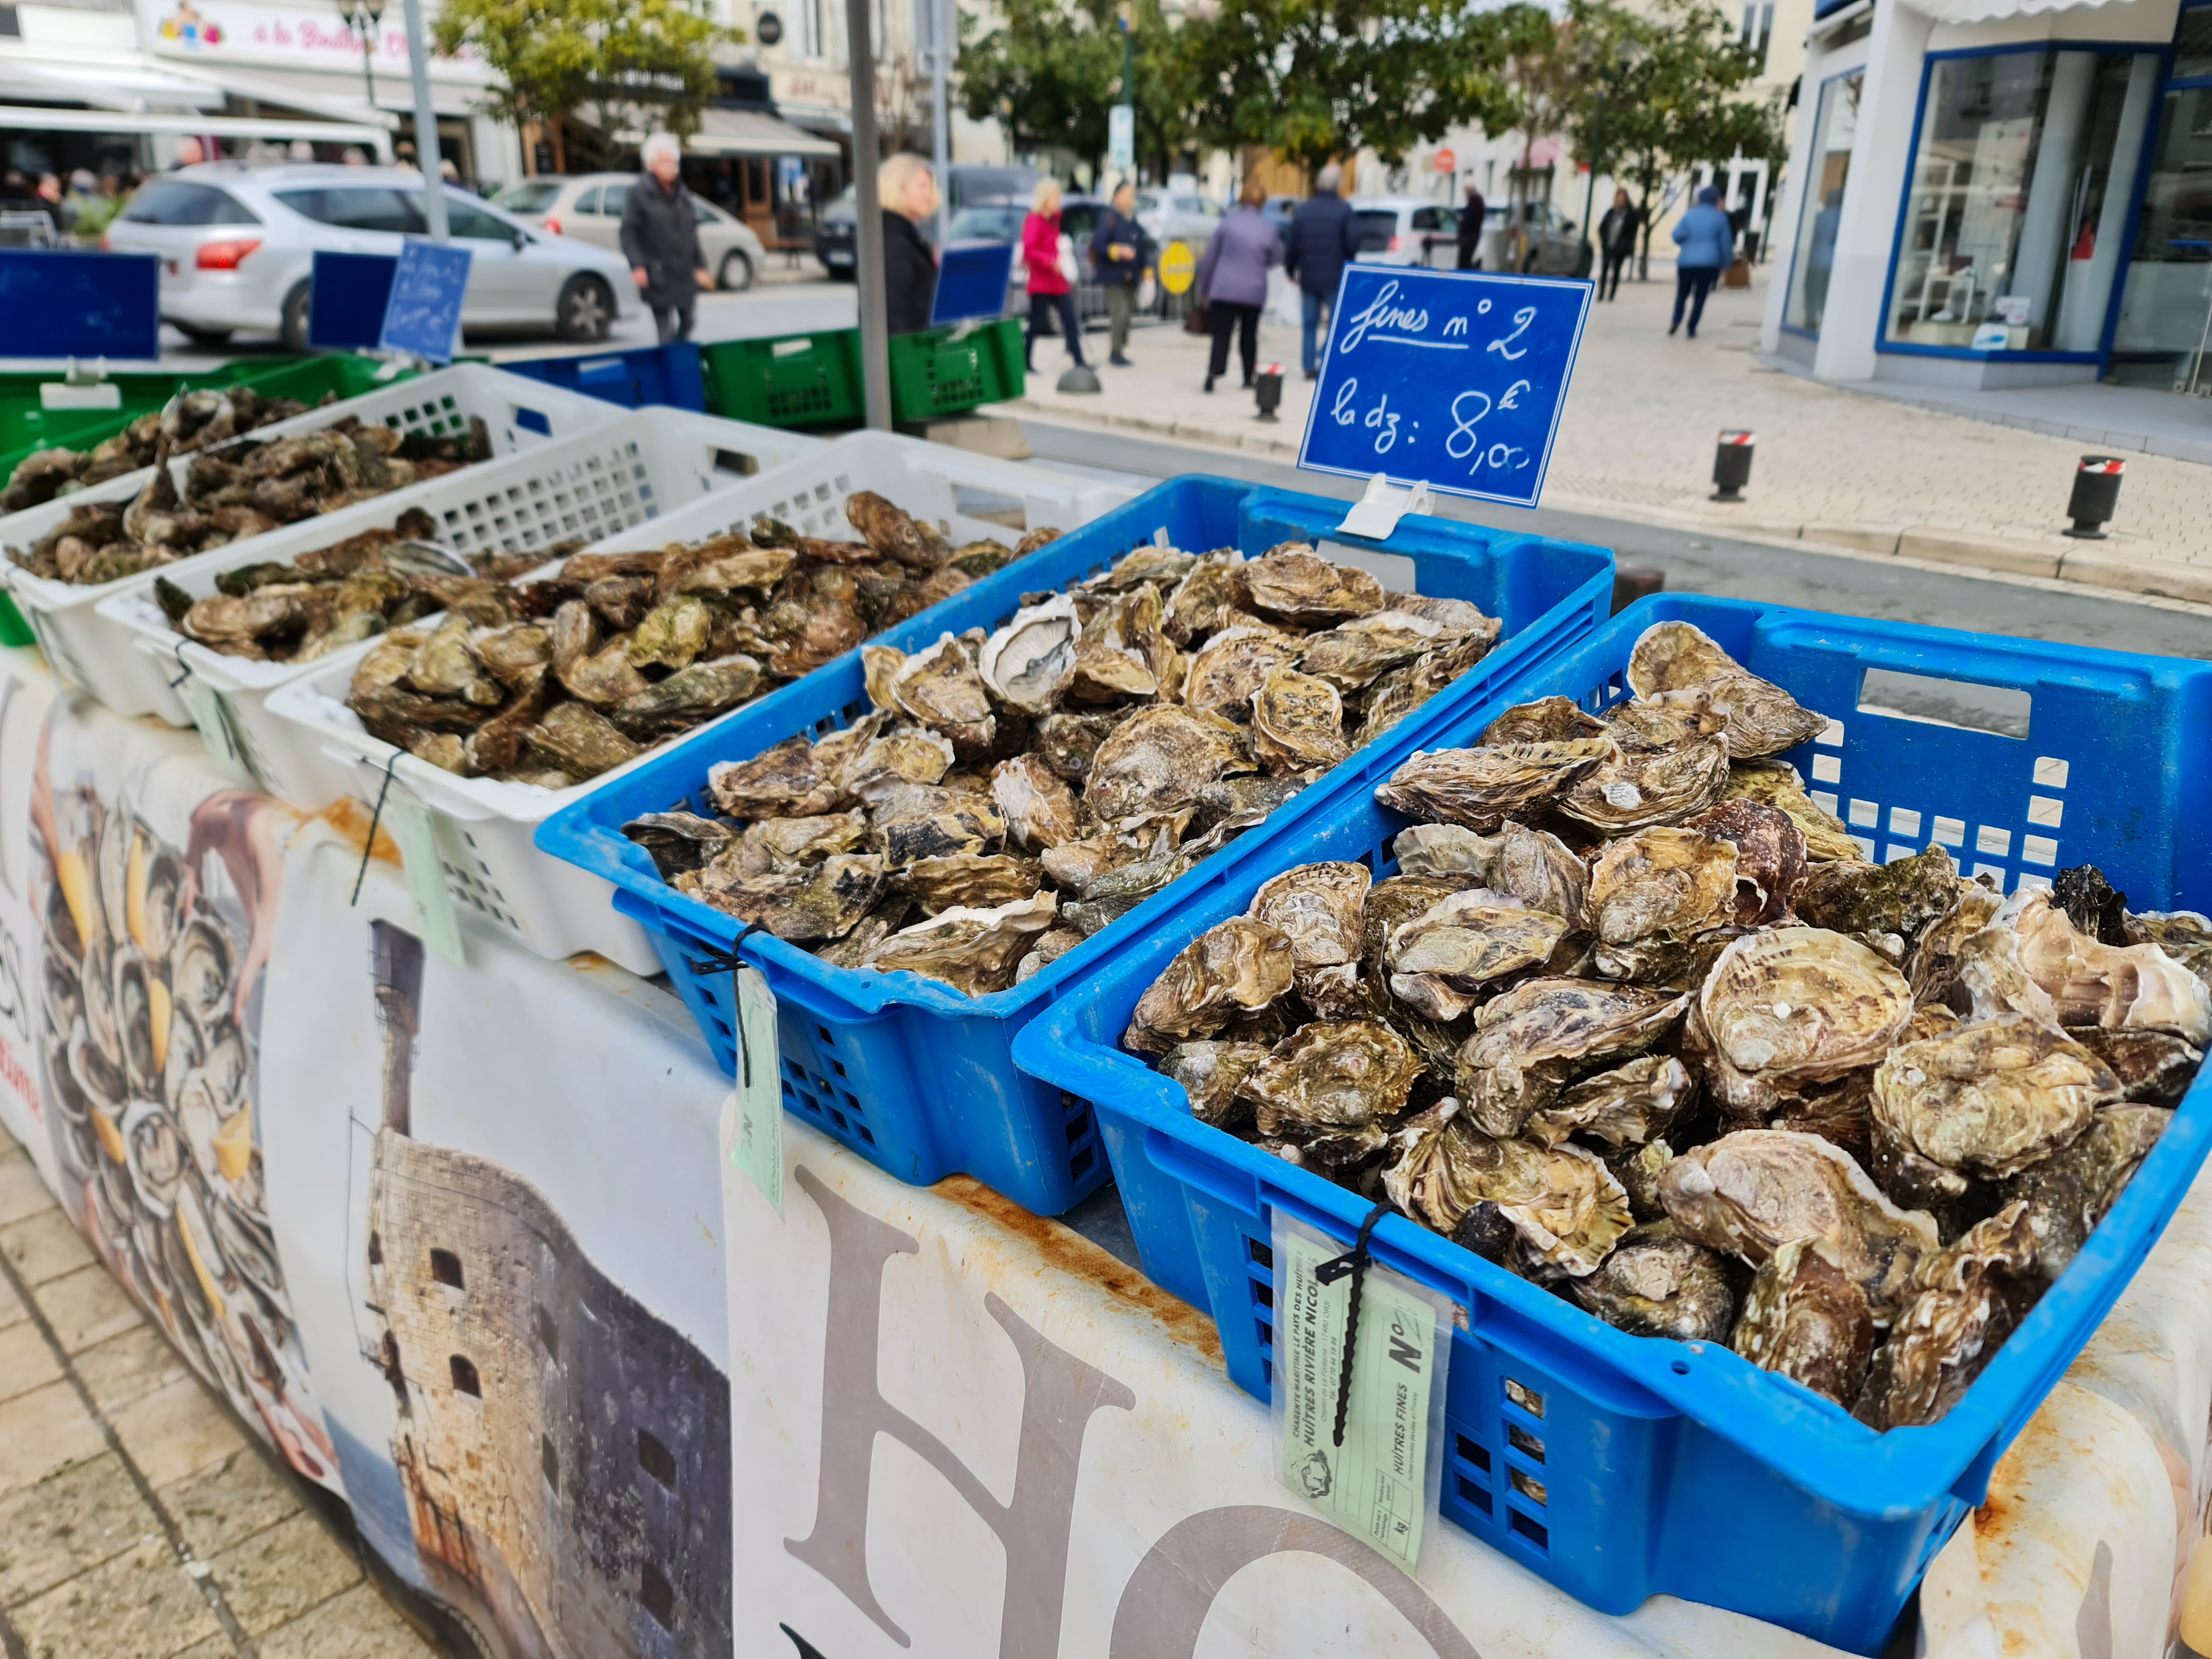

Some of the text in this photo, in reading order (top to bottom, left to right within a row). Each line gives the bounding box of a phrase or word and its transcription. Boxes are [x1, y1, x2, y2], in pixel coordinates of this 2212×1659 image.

[1339, 279, 1428, 354] fines
[1486, 306, 1537, 361] 2
[1330, 377, 1358, 426] la
[1293, 1291, 1302, 1312] DES
[1293, 1336, 1301, 1348] LE
[1321, 1319, 1329, 1341] 17480
[1293, 1348, 1301, 1392] MARITIME
[1302, 1327, 1316, 1385] RIVIÈRE
[1292, 1391, 1301, 1438] CHARENTE
[1302, 1386, 1316, 1448] HUÎTRES
[1391, 1382, 1408, 1476] HUÎTRES FINES
[1394, 1520, 1409, 1535] kg
